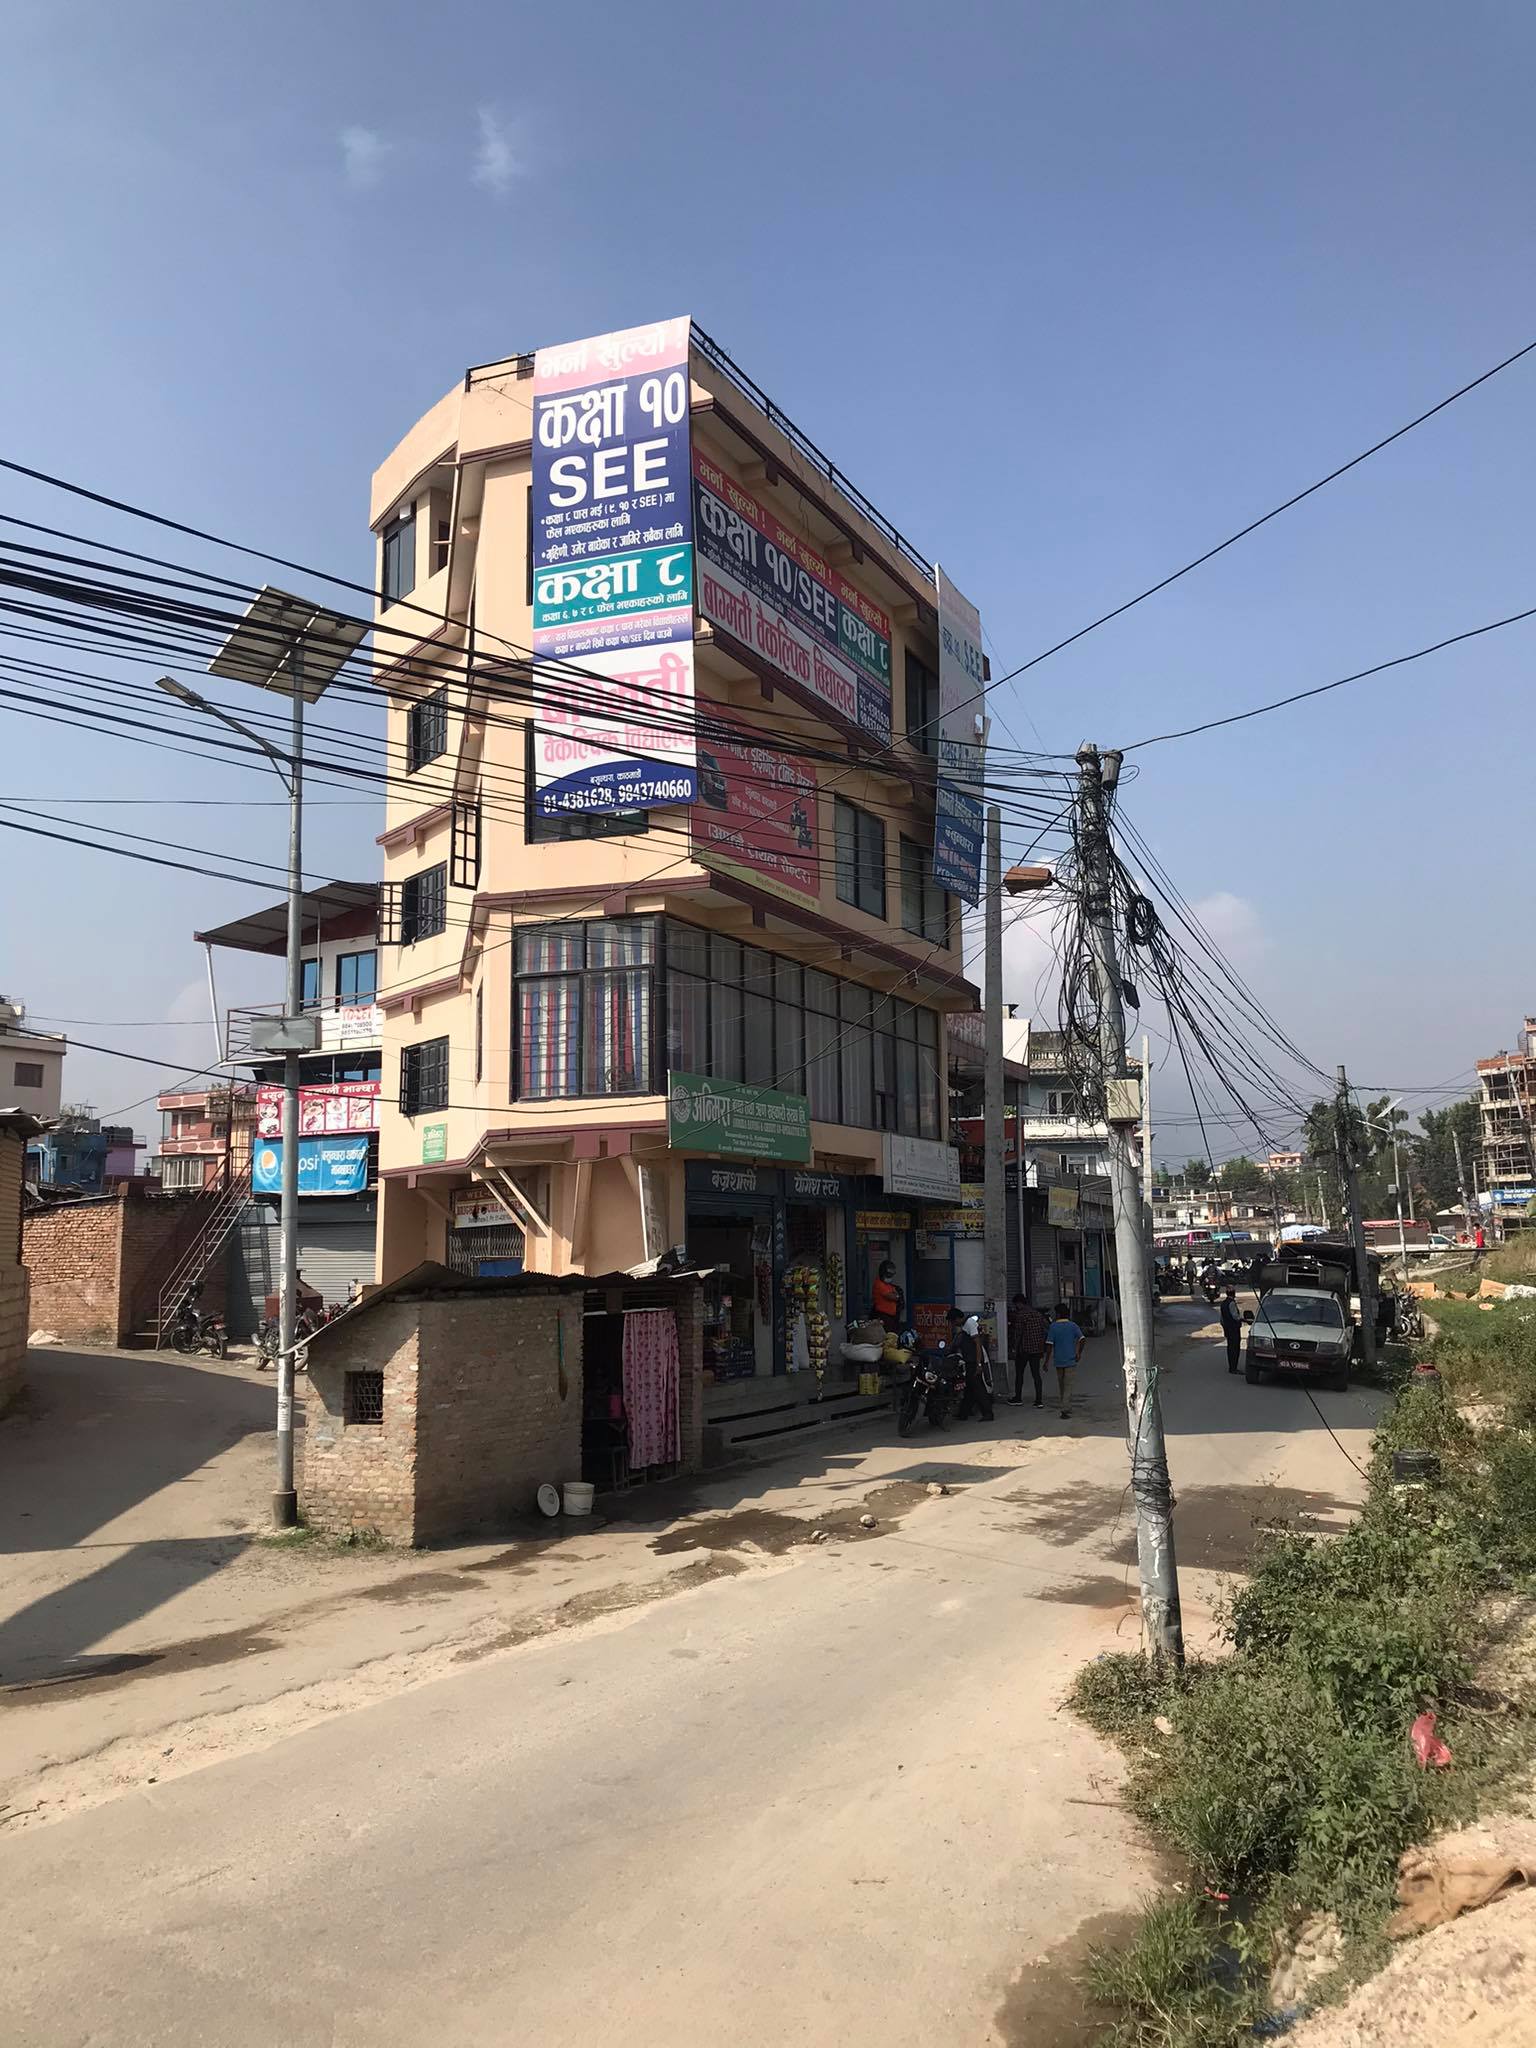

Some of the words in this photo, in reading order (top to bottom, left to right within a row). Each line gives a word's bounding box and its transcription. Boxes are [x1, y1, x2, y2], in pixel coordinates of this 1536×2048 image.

[538, 384, 628, 448] कक्षा
[640, 372, 686, 428] १०
[549, 437, 669, 507] SEE
[546, 513, 563, 524] कक्षा
[573, 508, 588, 519] पास
[546, 526, 562, 539] फेल
[611, 512, 631, 527] लागि
[537, 558, 642, 605] कक्षा
[656, 552, 685, 586] ८
[699, 483, 758, 568] कक्षा
[842, 606, 876, 660] कक्षा
[879, 642, 888, 671] ८
[542, 611, 561, 622] कक्षा
[597, 602, 615, 613] फेल
[618, 779, 692, 803] 9843740660
